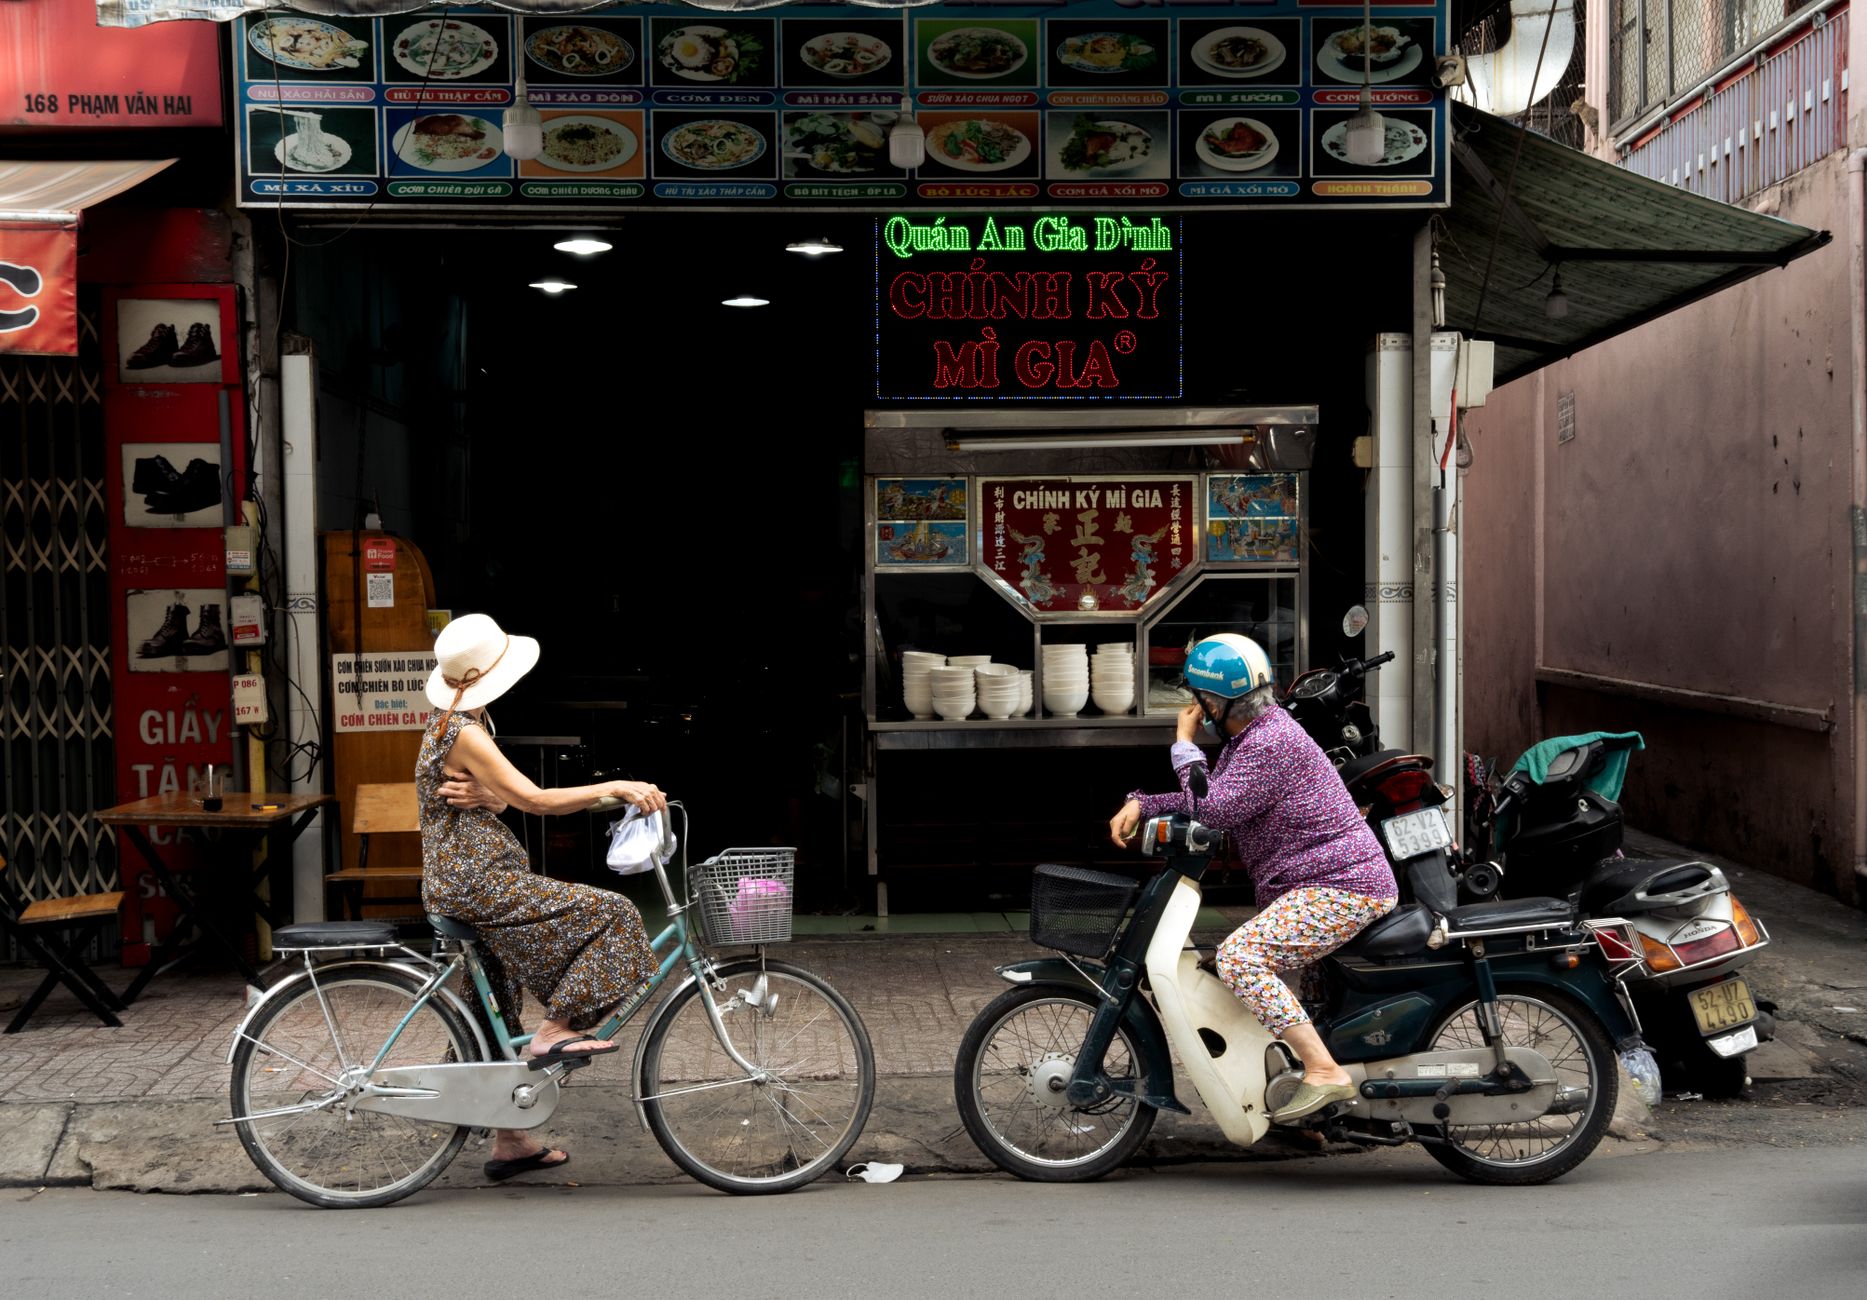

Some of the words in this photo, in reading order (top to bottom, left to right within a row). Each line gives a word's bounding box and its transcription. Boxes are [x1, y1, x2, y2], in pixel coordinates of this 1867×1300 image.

[438, 91, 471, 102] THẬP
[528, 92, 551, 102] MÌ
[555, 92, 591, 102] XÀO
[667, 94, 712, 102] CƠM
[975, 95, 1000, 103] CHUA
[1326, 94, 1360, 102] CƠM
[25, 94, 59, 113] 168
[68, 94, 119, 118] PHẠM
[125, 91, 158, 115] VĂN
[163, 95, 192, 115] HAI
[264, 184, 289, 192] MÌ
[398, 186, 425, 194] CƠM
[527, 186, 550, 195] CƠM
[884, 216, 971, 258] Quán
[976, 216, 1026, 251] An
[1033, 216, 1088, 251] Gia
[1094, 216, 1173, 251] Đình
[889, 257, 1072, 319] CHÍNH
[1086, 257, 1169, 319] KÝ
[933, 326, 1000, 388] MÌ
[1013, 484, 1071, 510] CHÍNH
[1076, 484, 1101, 509] KÝ
[1106, 484, 1127, 509] MÌ
[1131, 489, 1163, 509] GIA
[241, 679, 257, 688] 086
[236, 706, 251, 716] 167
[341, 713, 365, 727] CƠM
[368, 711, 399, 726] CHIÊN
[1398, 828, 1443, 855] 5399
[1684, 924, 1717, 940] HONDA
[1706, 1002, 1749, 1029] 4490
